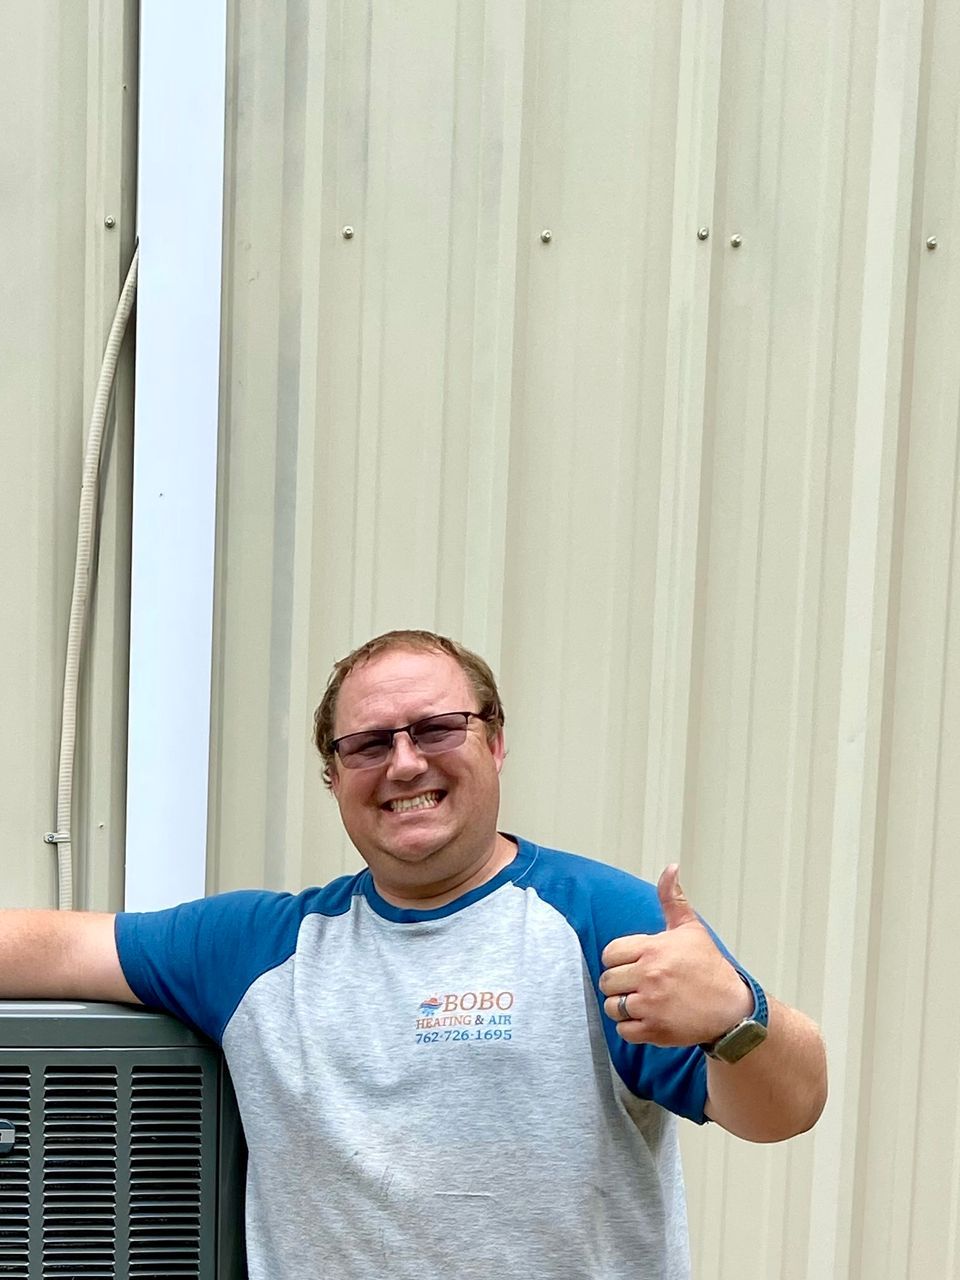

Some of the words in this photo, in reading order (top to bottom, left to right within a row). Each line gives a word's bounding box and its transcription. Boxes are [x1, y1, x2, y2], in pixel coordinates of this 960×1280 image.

[442, 991, 514, 1013] BOBO
[415, 1014, 472, 1030] HEATING
[474, 1014, 484, 1025] &
[488, 1014, 512, 1025] AIR
